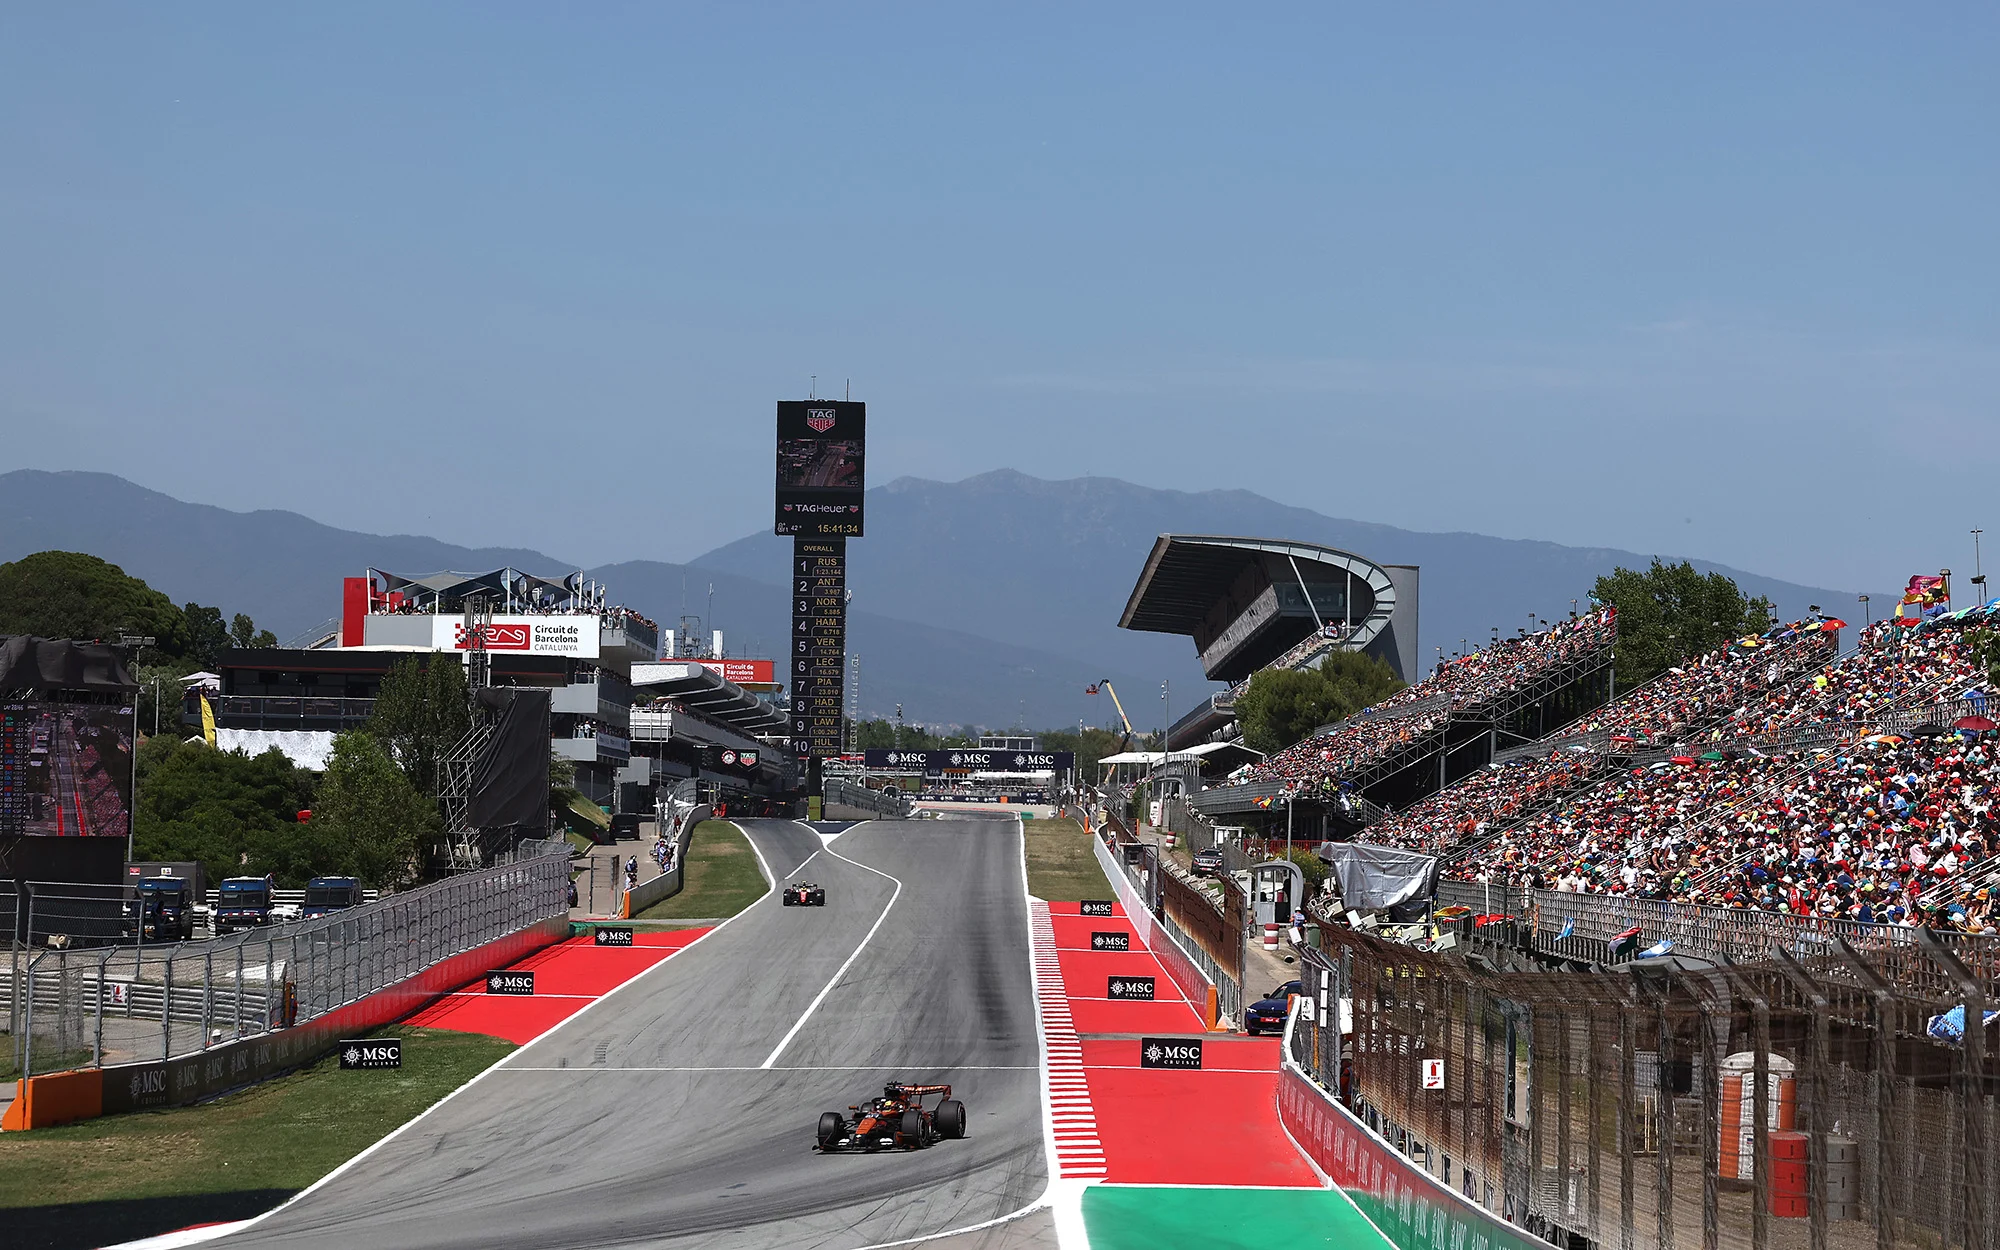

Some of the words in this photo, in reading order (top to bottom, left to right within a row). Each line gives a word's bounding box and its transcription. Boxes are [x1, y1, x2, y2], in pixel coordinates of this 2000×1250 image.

[810, 410, 833, 418] TAG
[808, 419, 834, 431] HEUER
[818, 524, 858, 533] 15:41:34
[800, 561, 806, 571] 1
[817, 558, 837, 566] RUS
[799, 581, 807, 591] 2
[817, 578, 836, 586] ANT
[799, 601, 807, 611] 3
[816, 598, 837, 606] NOR
[535, 625, 566, 634] Circuit
[566, 626, 579, 634] de
[798, 621, 807, 631] 4
[815, 618, 837, 626] HAM
[535, 634, 578, 643] Barcelona
[798, 641, 806, 652] 5
[816, 638, 835, 646] VER
[798, 661, 806, 671] 6
[816, 658, 834, 666] LEC
[797, 681, 805, 691] 7
[817, 678, 832, 686] PIA
[797, 701, 805, 711] 8
[814, 698, 834, 706] HAD
[796, 721, 804, 731] 9
[814, 718, 835, 726] LAW
[793, 741, 808, 752] 10
[814, 738, 833, 746] HUL
[900, 752, 927, 763] MSC
[963, 753, 991, 764] MSC
[1027, 755, 1054, 765] MSC
[1092, 904, 1111, 912] MSC
[608, 931, 632, 940] MSC
[1105, 937, 1128, 946] MSC
[504, 977, 533, 988] MSC
[1125, 982, 1153, 993] MSC
[363, 1047, 399, 1061] MSC
[1164, 1046, 1200, 1059] MSC
[211, 1056, 225, 1080] MSC
[142, 1069, 167, 1093] MSC
[183, 1064, 198, 1087] MSC
